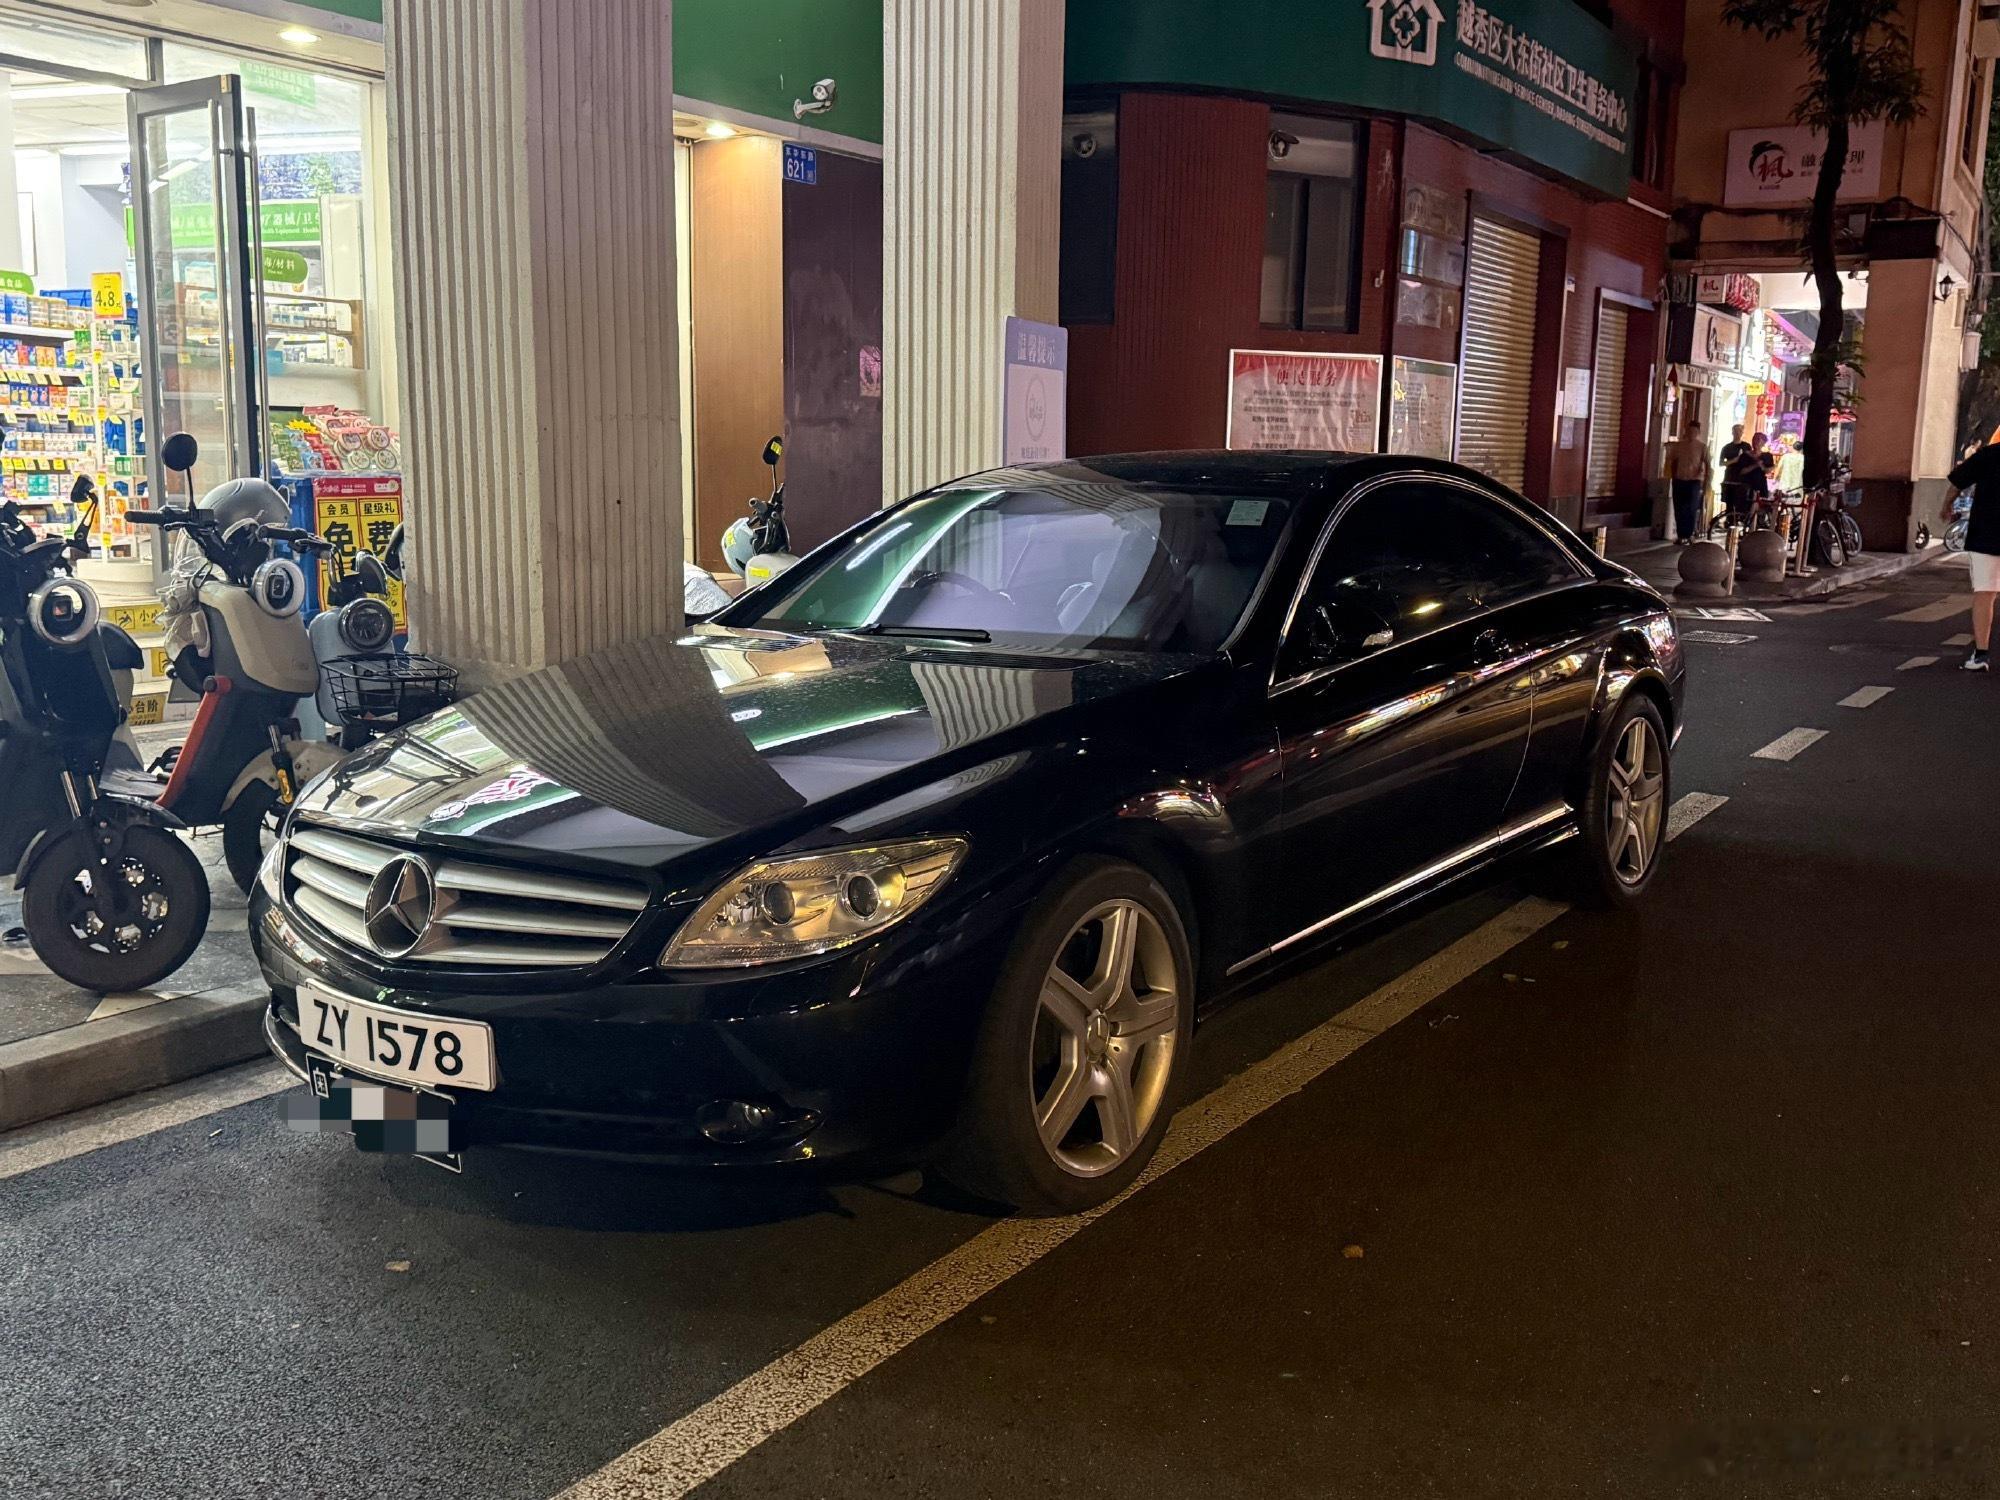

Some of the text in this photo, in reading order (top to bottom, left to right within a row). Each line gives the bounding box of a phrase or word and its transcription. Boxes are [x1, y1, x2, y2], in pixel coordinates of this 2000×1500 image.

[1456, 0, 1628, 132] 越秀区大东街社区卫生服务中心
[787, 158, 804, 180] 621
[1277, 368, 1338, 387] 便民服务
[327, 502, 394, 515] 会员 星级礼
[129, 699, 159, 714] 台阶
[313, 998, 464, 1077] ZY 1578
